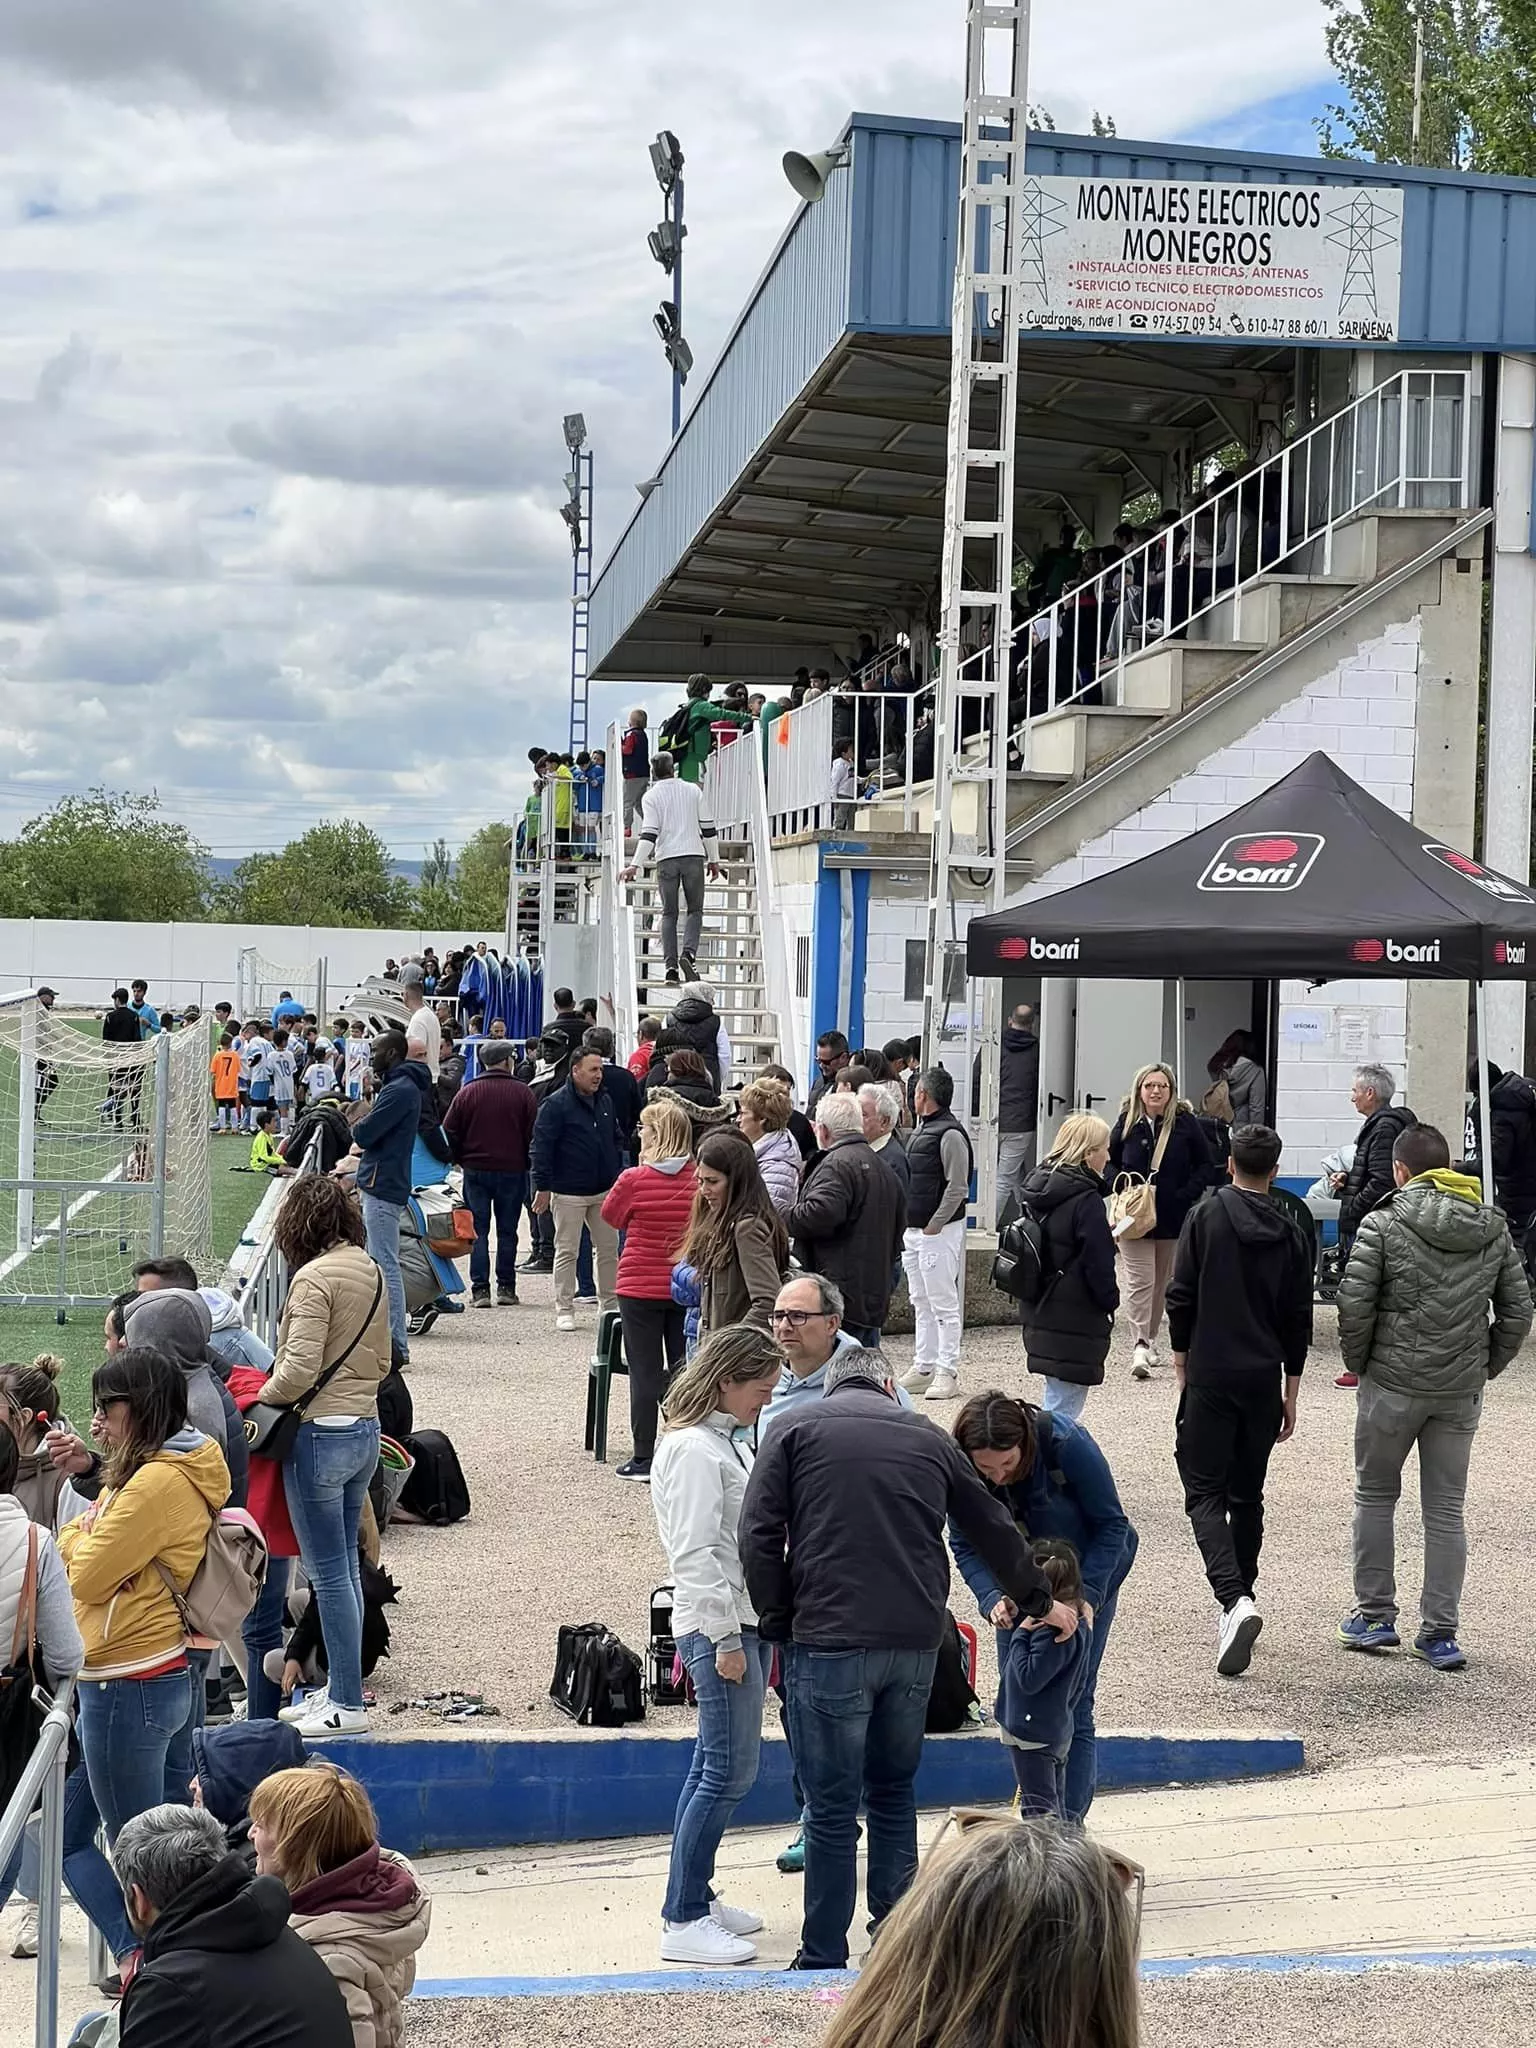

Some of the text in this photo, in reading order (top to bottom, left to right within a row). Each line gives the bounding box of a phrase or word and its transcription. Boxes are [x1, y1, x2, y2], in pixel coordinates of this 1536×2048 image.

[1077, 184, 1321, 229] MONTAJES ELECTRICOS
[1122, 228, 1272, 266] MONEGROS
[1076, 261, 1309, 280] INSTALACIONES ELECTRICAS, ANTENAS
[1076, 279, 1324, 299] SERVICIO TECNICO ELECTRODOMESTICOS
[1075, 298, 1216, 313] AIRE ACONDICIONADO
[1152, 315, 1188, 330] 974-57
[1192, 316, 1206, 331] 09
[1208, 316, 1222, 332] 54
[1247, 318, 1285, 333] 610-47
[1288, 319, 1301, 334] 88
[1304, 319, 1328, 335] 60/1
[1211, 862, 1298, 883] barri
[1030, 936, 1080, 960] barri
[1386, 938, 1440, 962] barri
[1506, 940, 1526, 964] barri
[222, 1056, 233, 1076] 7
[316, 1071, 325, 1088] 5
